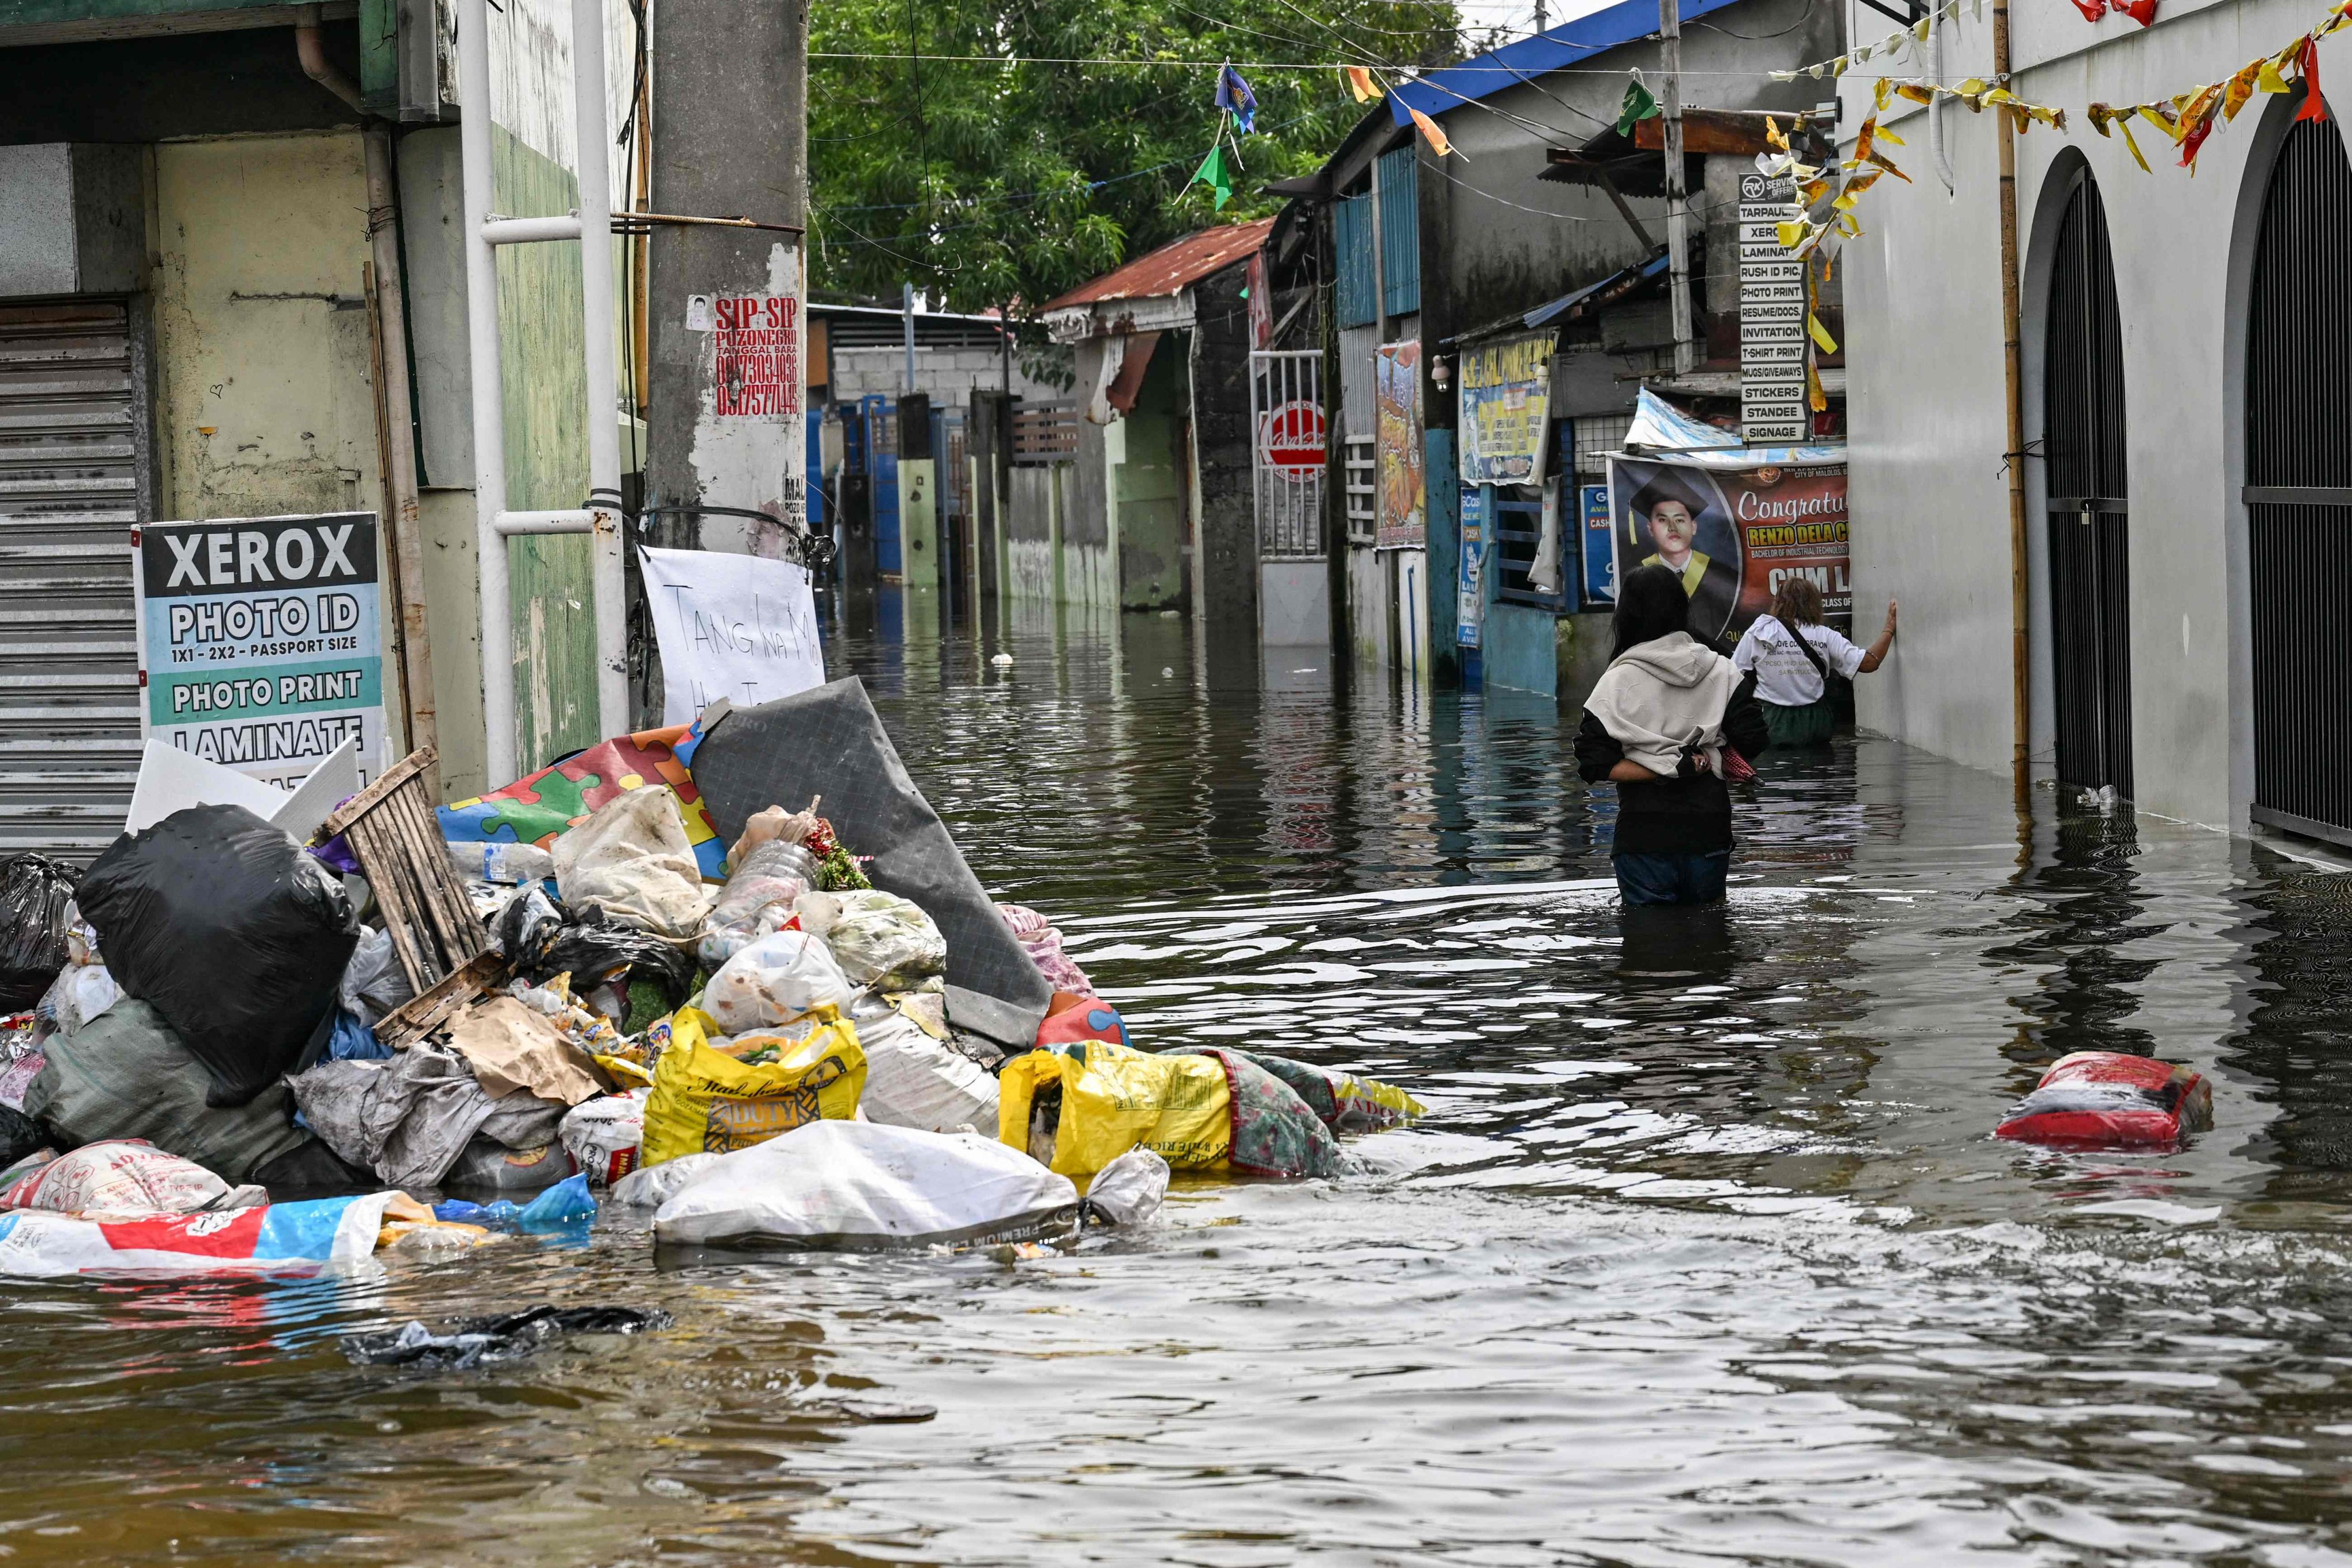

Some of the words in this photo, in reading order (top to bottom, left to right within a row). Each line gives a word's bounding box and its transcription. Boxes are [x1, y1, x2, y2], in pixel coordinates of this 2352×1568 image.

[1767, 177, 1794, 190] SERVI
[1741, 208, 1794, 217] TARPAUL
[1751, 228, 1779, 237] XERO
[1743, 248, 1791, 257] LAMINAT
[1741, 267, 1768, 277] RUSH
[1771, 267, 1779, 276] ID
[1783, 266, 1800, 276] PIC.
[1741, 288, 1771, 298] PHOTO
[1774, 287, 1800, 297] PRINT
[716, 298, 797, 330] SIP-SIP
[1742, 307, 1801, 317] RESUME/DOCS.
[1743, 327, 1800, 337] INVITATION
[716, 329, 797, 347] POZONEGRO
[716, 346, 772, 355] TANGGAL
[774, 346, 797, 354] BARA
[1743, 348, 1774, 358] T-SHIRT
[1777, 347, 1801, 357] PRINT
[1742, 367, 1802, 377] MUGS/GIVEAWAYS
[1745, 387, 1799, 397] STICKERS
[1747, 407, 1797, 418] STANDEE
[1749, 427, 1797, 438] SIGNAGE
[1462, 495, 1480, 508] GCas
[1738, 491, 1848, 524] Congratu
[1590, 519, 1611, 528] CASH
[1748, 526, 1795, 547] RENZO
[1797, 522, 1835, 545] DELA
[164, 524, 357, 588] XEROX
[1751, 549, 1778, 558] BACHELOR
[1786, 547, 1815, 556] INDUSTRIAL
[1816, 545, 1848, 555] TECHNOLOGY
[1834, 565, 1852, 593] L
[1822, 598, 1843, 608] CLASS
[1843, 597, 1852, 607] OF
[169, 596, 309, 644] PHOTO
[317, 593, 360, 634] ID
[171, 647, 194, 663] 1X1
[208, 646, 235, 661] 2X2
[250, 639, 324, 658] PASSPORT
[328, 636, 357, 650] SIZE
[173, 677, 273, 713] PHOTO
[279, 670, 362, 705] PRINT
[733, 1099, 795, 1124] DUTY
[974, 1223, 1041, 1247] PREMIUM
